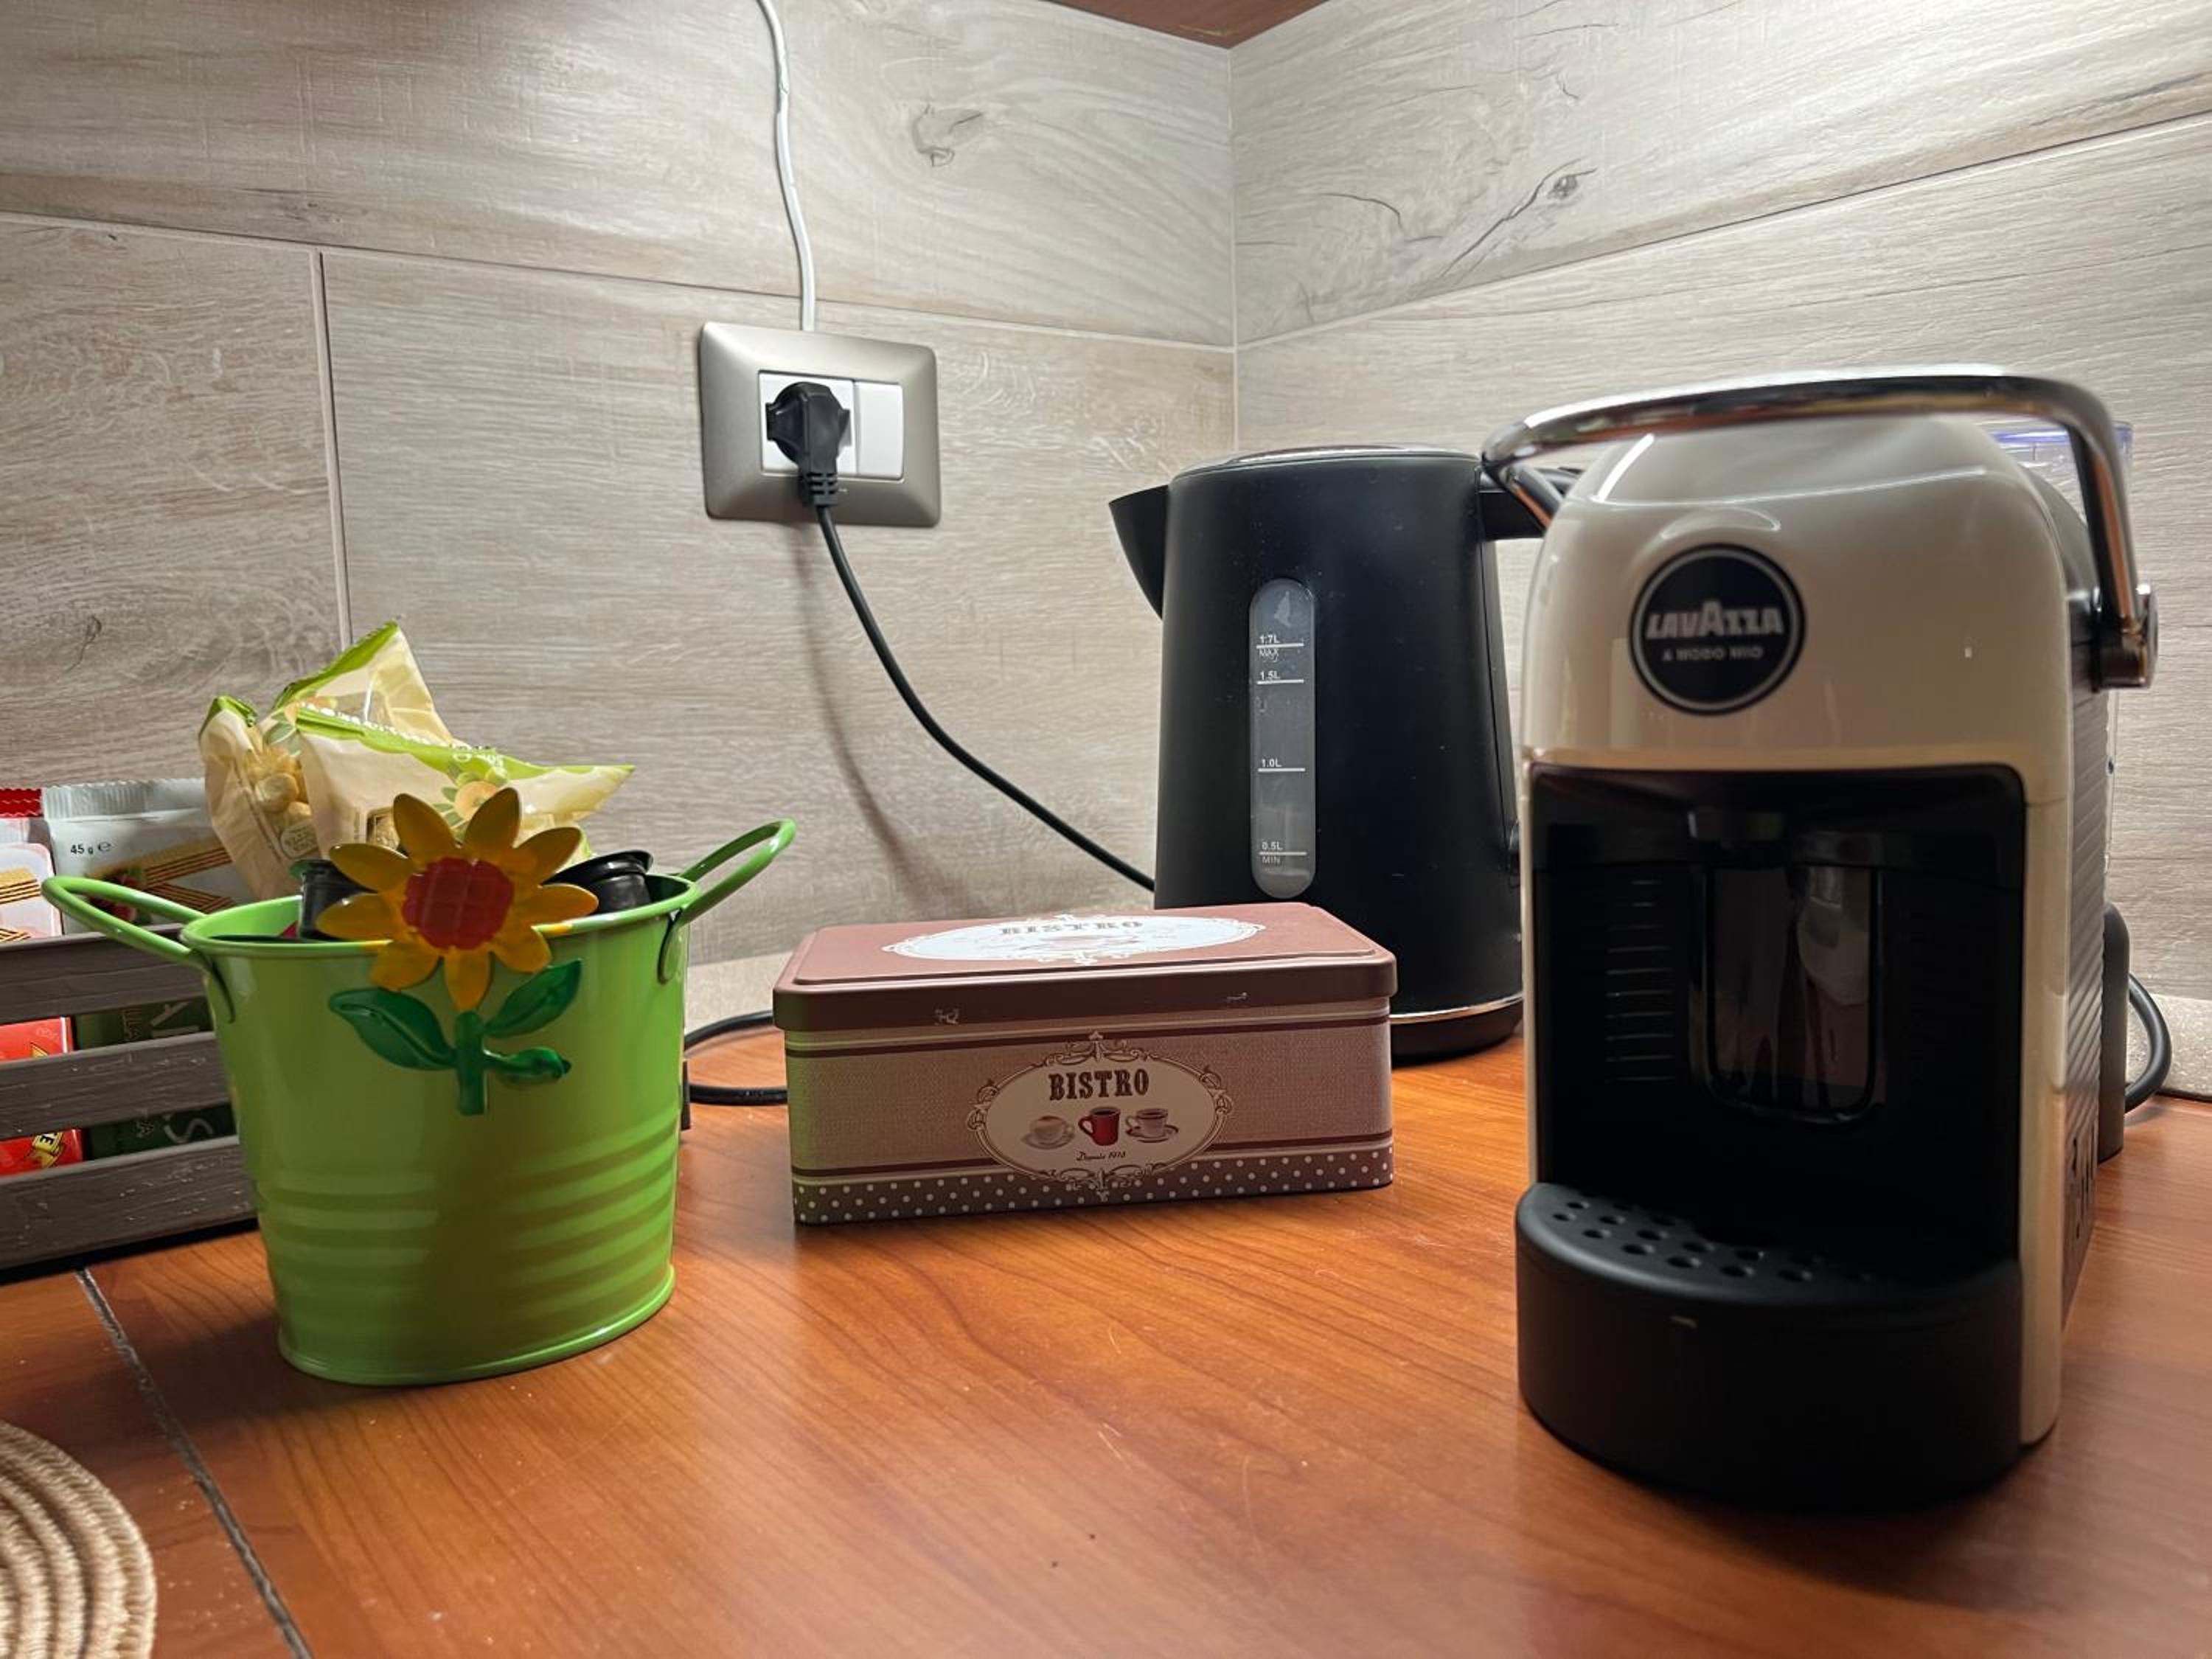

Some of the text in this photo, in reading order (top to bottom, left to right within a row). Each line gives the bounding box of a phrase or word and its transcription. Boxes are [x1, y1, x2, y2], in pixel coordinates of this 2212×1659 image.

[1646, 600, 1784, 640] LAVAZZA
[1260, 634, 1281, 644] 1.7L
[1262, 759, 1282, 768] 1.0L
[70, 844, 84, 854] 45
[1262, 841, 1283, 850] 0.5L
[1002, 921, 1143, 935] BISTRO
[1048, 1068, 1150, 1101] BISTRO
